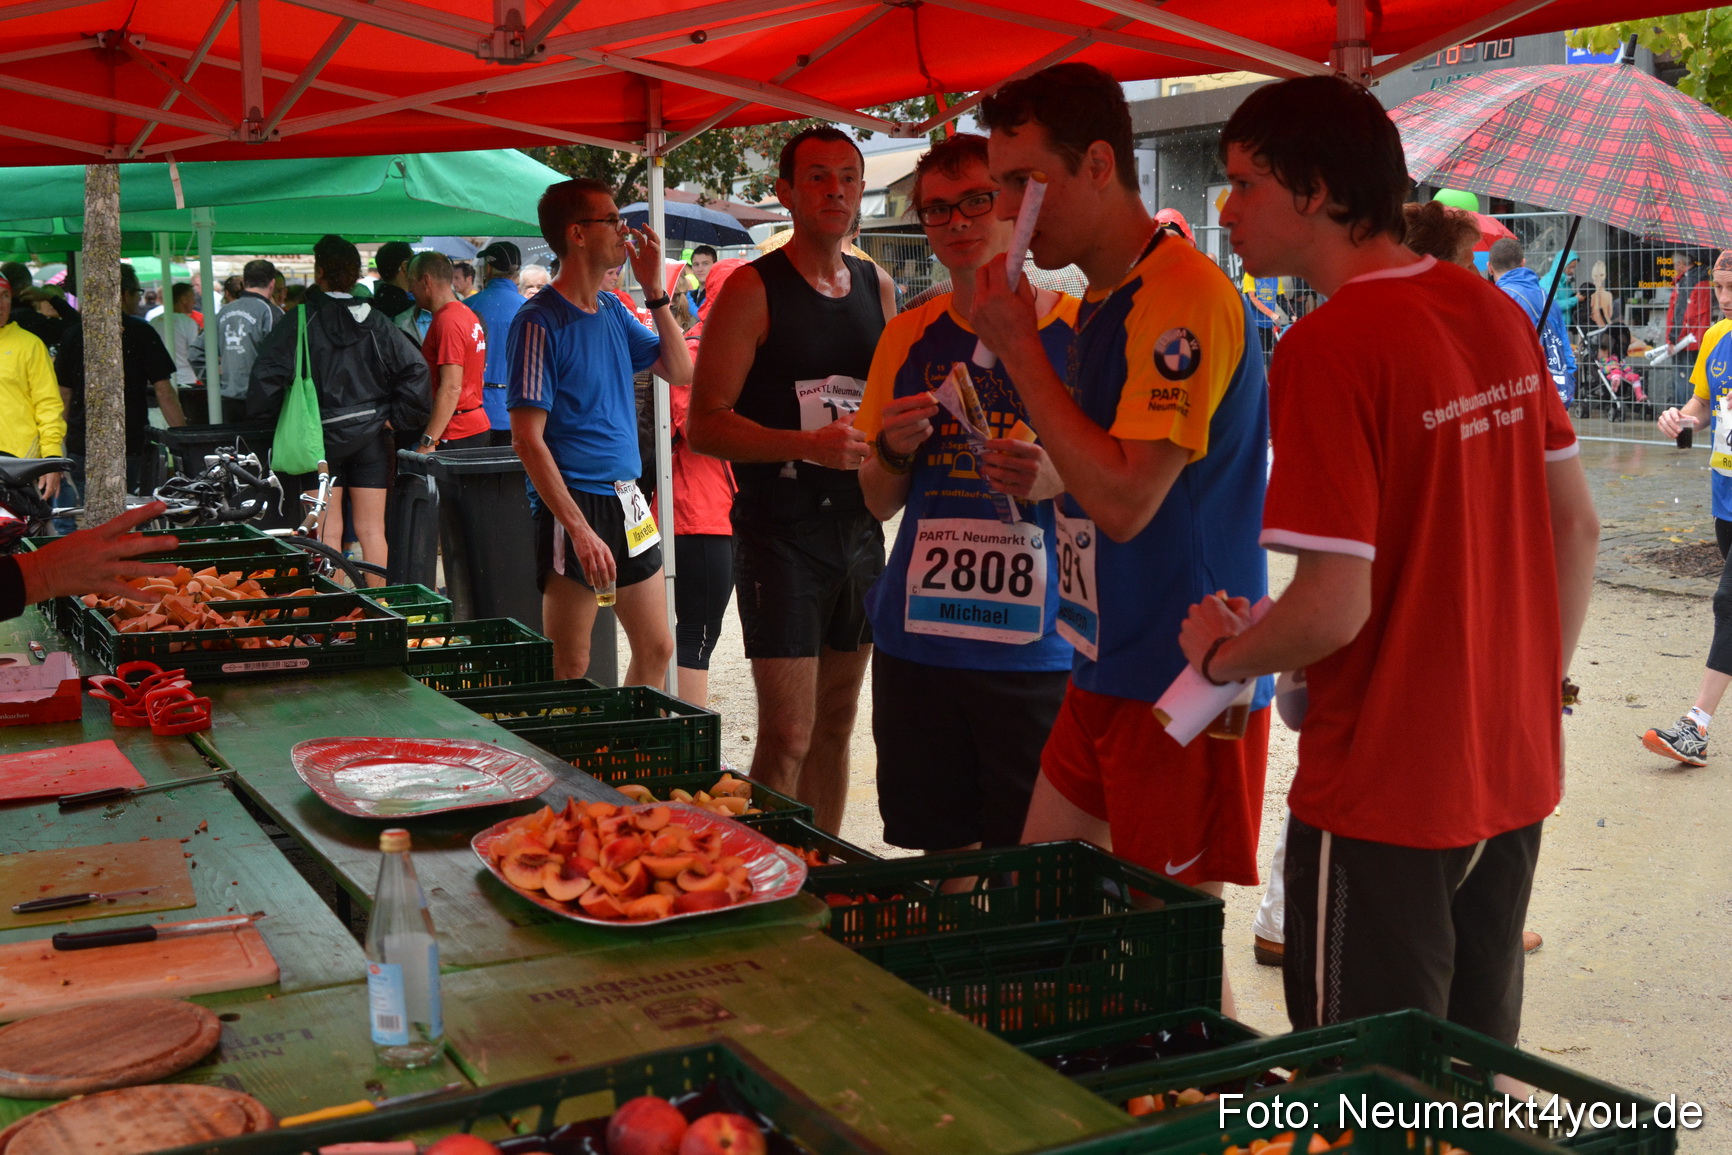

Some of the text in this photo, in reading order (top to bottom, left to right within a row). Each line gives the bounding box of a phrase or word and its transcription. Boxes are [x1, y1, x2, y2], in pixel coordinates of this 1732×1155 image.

[799, 384, 831, 397] PARTL
[1422, 400, 1461, 430] Stadt
[1459, 383, 1508, 413] Neumarkt
[1493, 406, 1524, 427] Team
[919, 530, 1025, 546] PARTL Neumarkt
[921, 546, 1034, 598] 2808
[940, 603, 1009, 625] Michael
[575, 975, 745, 1008] Neumarkter
